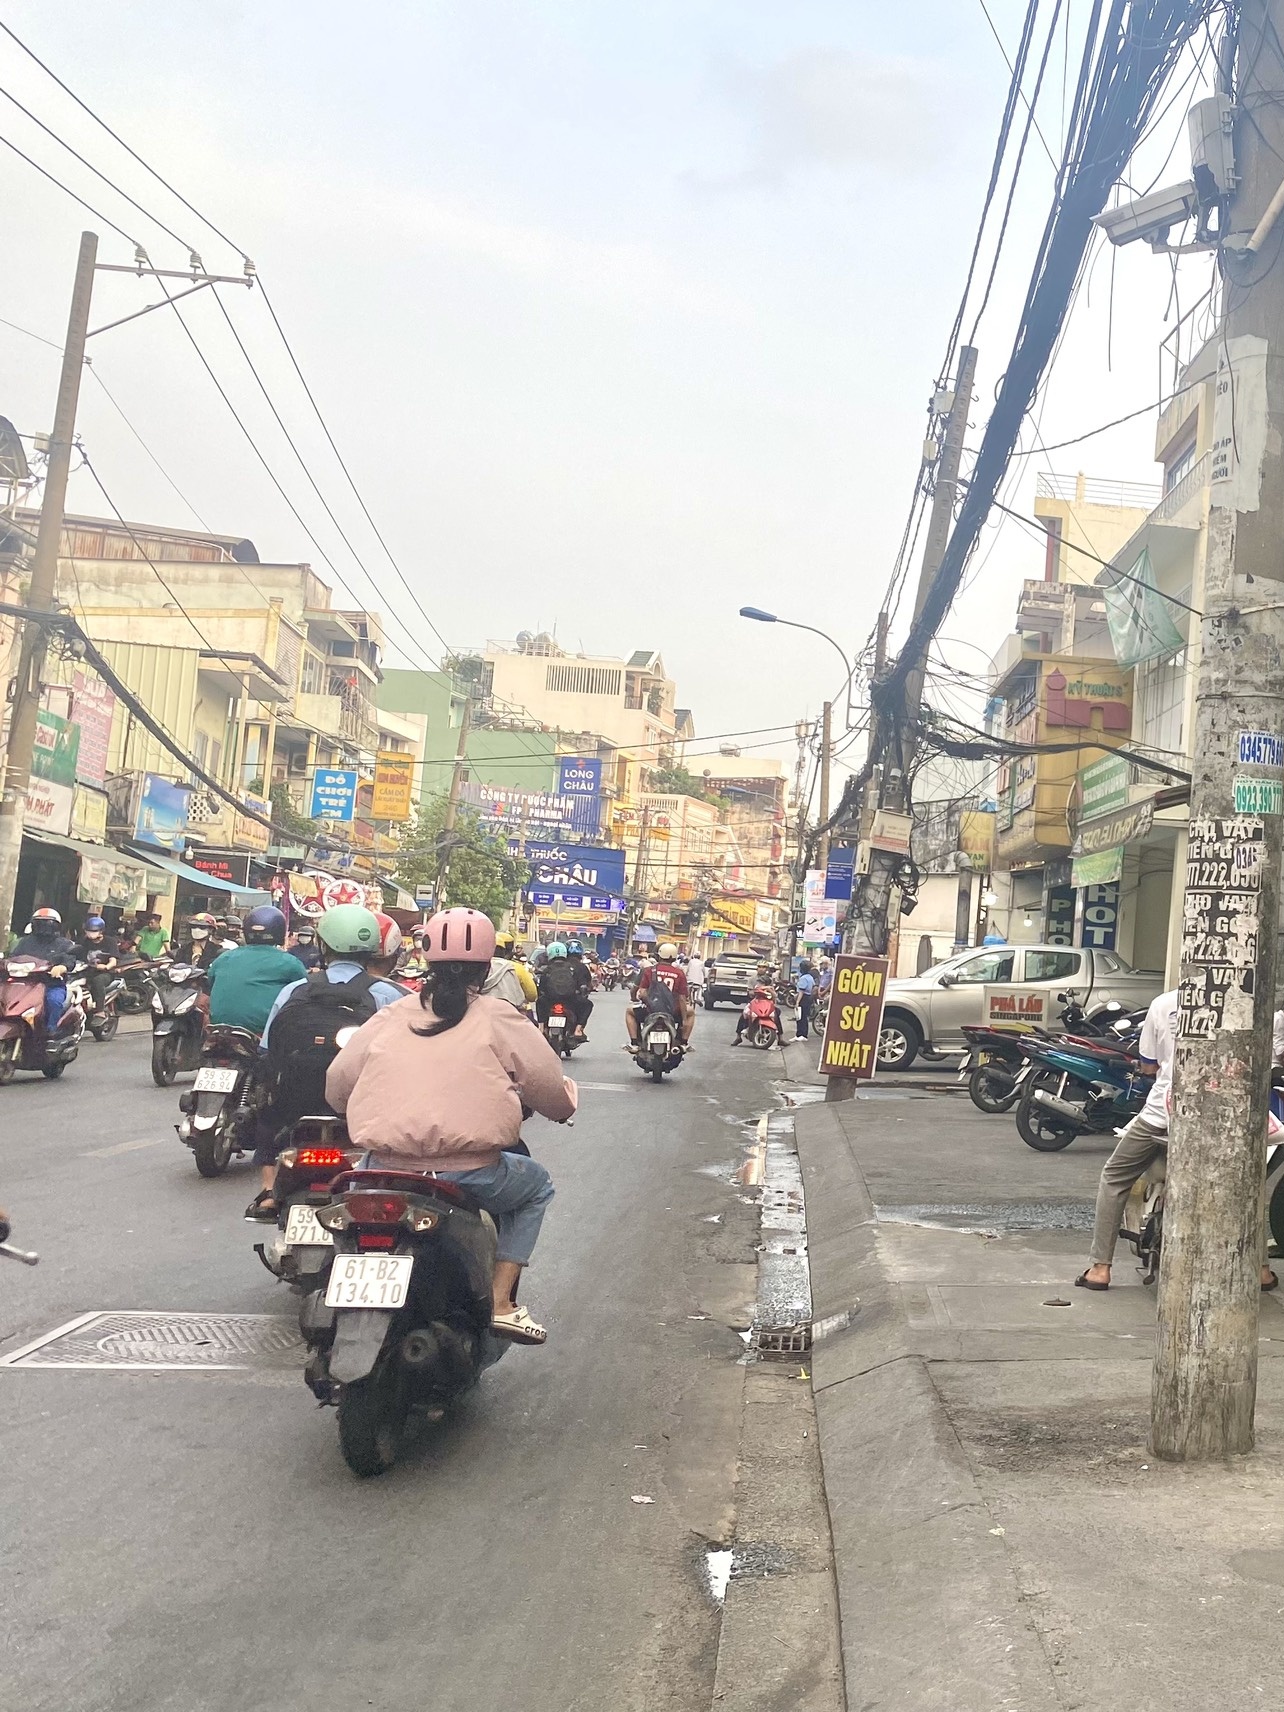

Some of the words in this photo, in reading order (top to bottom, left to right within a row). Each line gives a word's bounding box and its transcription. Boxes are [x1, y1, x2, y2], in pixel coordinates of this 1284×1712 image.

[565, 769, 594, 779] LONG
[316, 786, 353, 796] CHƠI
[480, 788, 505, 802] CÔNG
[508, 792, 520, 804] TY
[563, 780, 594, 791] CHÂU
[529, 808, 563, 820] PHARMA
[537, 863, 597, 886] CHÂU
[838, 963, 882, 997] GỐM
[840, 1002, 870, 1032] SỨ
[826, 1038, 872, 1073] NHẬT
[345, 1259, 400, 1280] 61-B2
[335, 1282, 402, 1303] 134.10
